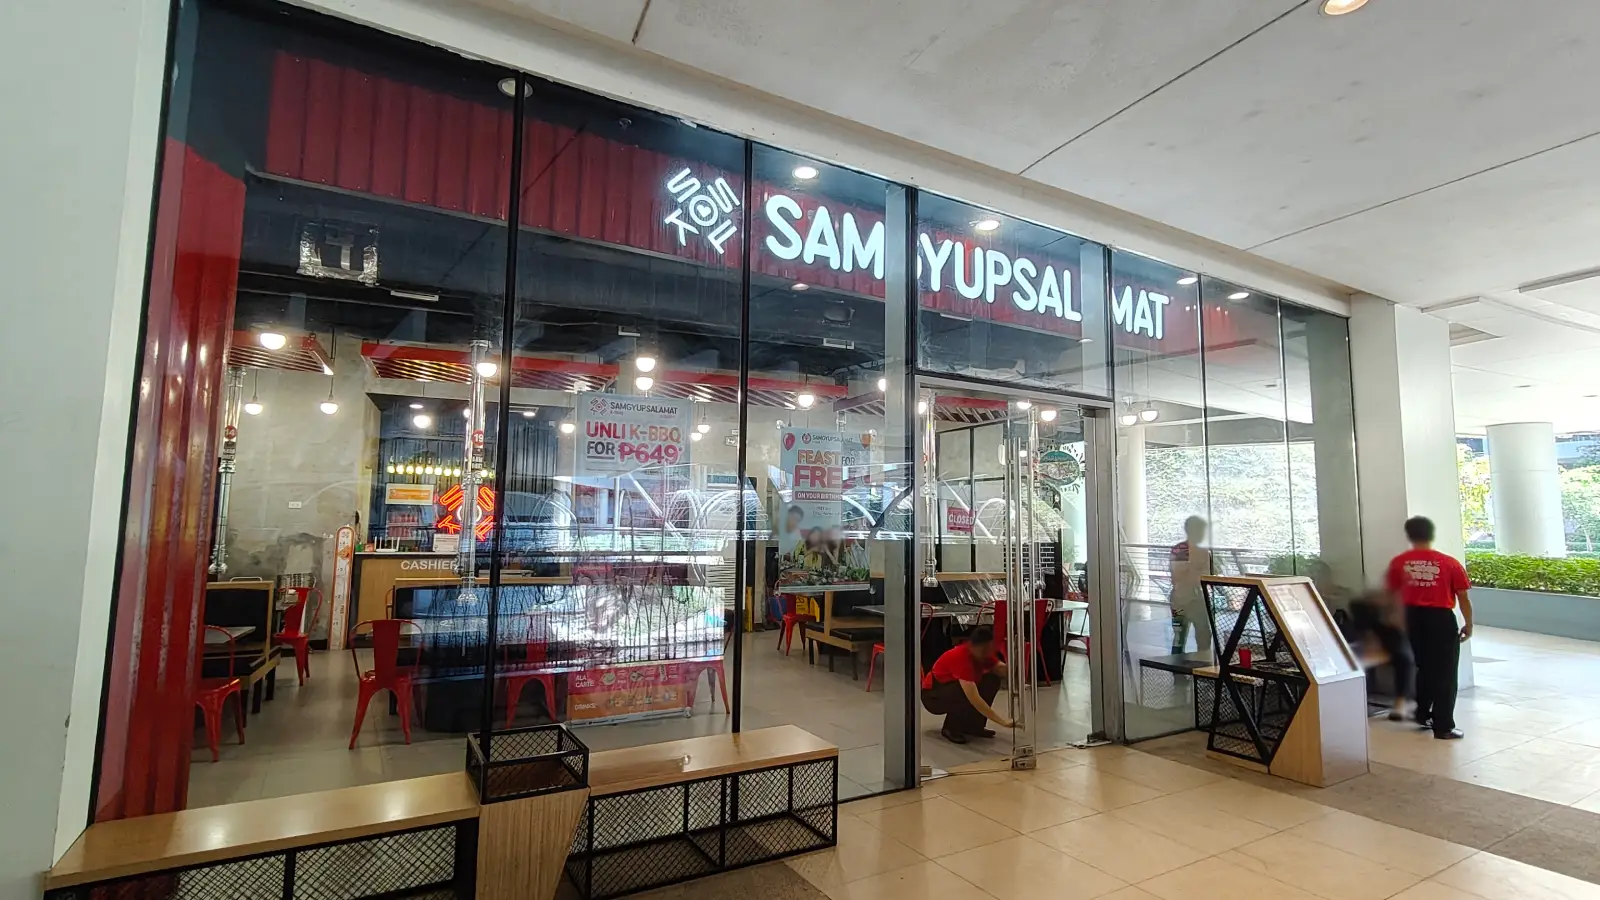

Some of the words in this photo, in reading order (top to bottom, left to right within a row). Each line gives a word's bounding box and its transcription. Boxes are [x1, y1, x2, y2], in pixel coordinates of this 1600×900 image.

[765, 194, 1170, 340] SAMYUPSALMAT
[610, 401, 678, 415] SAMGYUPSALAMAT
[473, 433, 484, 443] 19
[586, 421, 626, 439] UNLI
[630, 424, 681, 443] K-BBQ
[586, 441, 616, 456] FOR
[798, 449, 840, 465] FEAST
[841, 456, 856, 465] FOR
[948, 513, 975, 525] CLOSED
